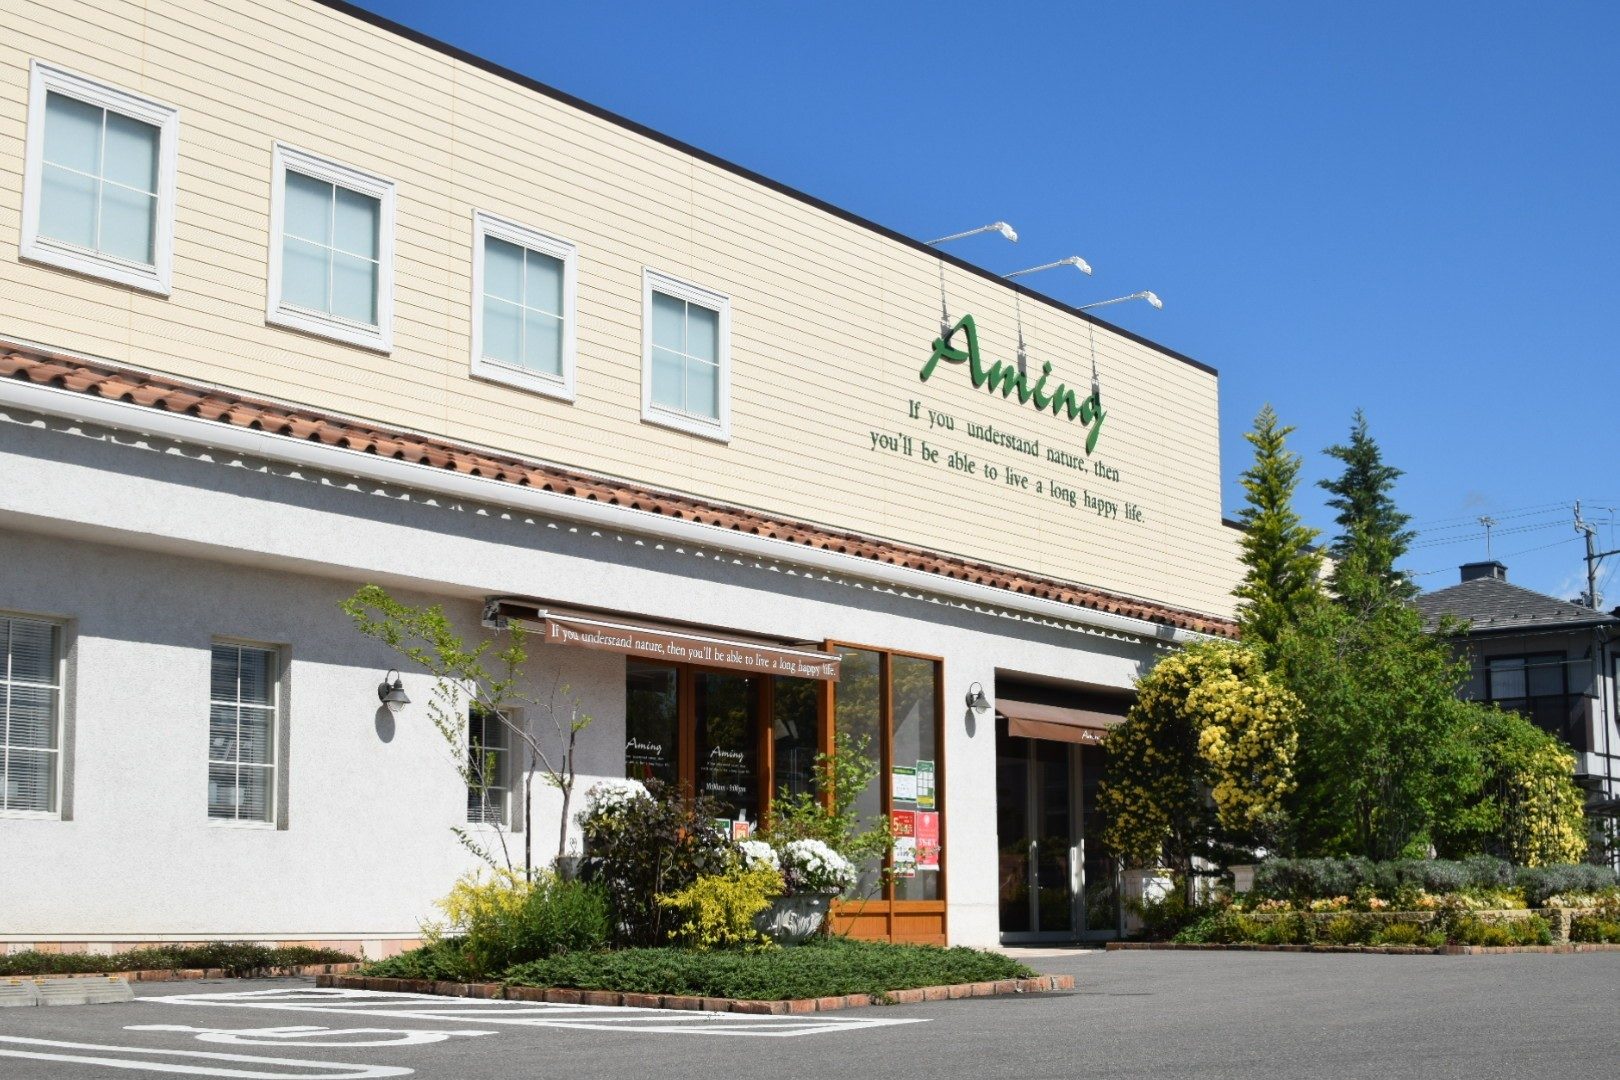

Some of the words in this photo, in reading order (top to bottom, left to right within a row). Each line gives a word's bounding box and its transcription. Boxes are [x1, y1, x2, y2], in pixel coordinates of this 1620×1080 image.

[919, 313, 1108, 456] Aming
[908, 399, 921, 419] If
[928, 409, 954, 430] you
[967, 422, 1039, 457] understand
[1046, 448, 1088, 474] nature,
[1094, 461, 1120, 483] then
[869, 431, 912, 456] you'll
[921, 442, 938, 463] be
[948, 451, 976, 474] able
[984, 461, 998, 480] to
[1006, 467, 1028, 489] live
[1035, 479, 1043, 494] a
[1050, 481, 1077, 508] long
[1084, 490, 1118, 520] happy
[1125, 503, 1145, 523] life.
[551, 623, 560, 637] If
[562, 629, 578, 642] you
[581, 631, 632, 648] understand
[635, 640, 665, 654] nature,
[667, 641, 686, 656] then
[688, 646, 711, 660] you'll
[715, 648, 724, 661] be
[726, 650, 743, 663] able
[745, 655, 754, 665] to
[755, 653, 769, 667] live
[779, 657, 796, 673] long
[798, 660, 820, 676] happy
[625, 736, 662, 755] Aming
[709, 745, 744, 763] Aming
